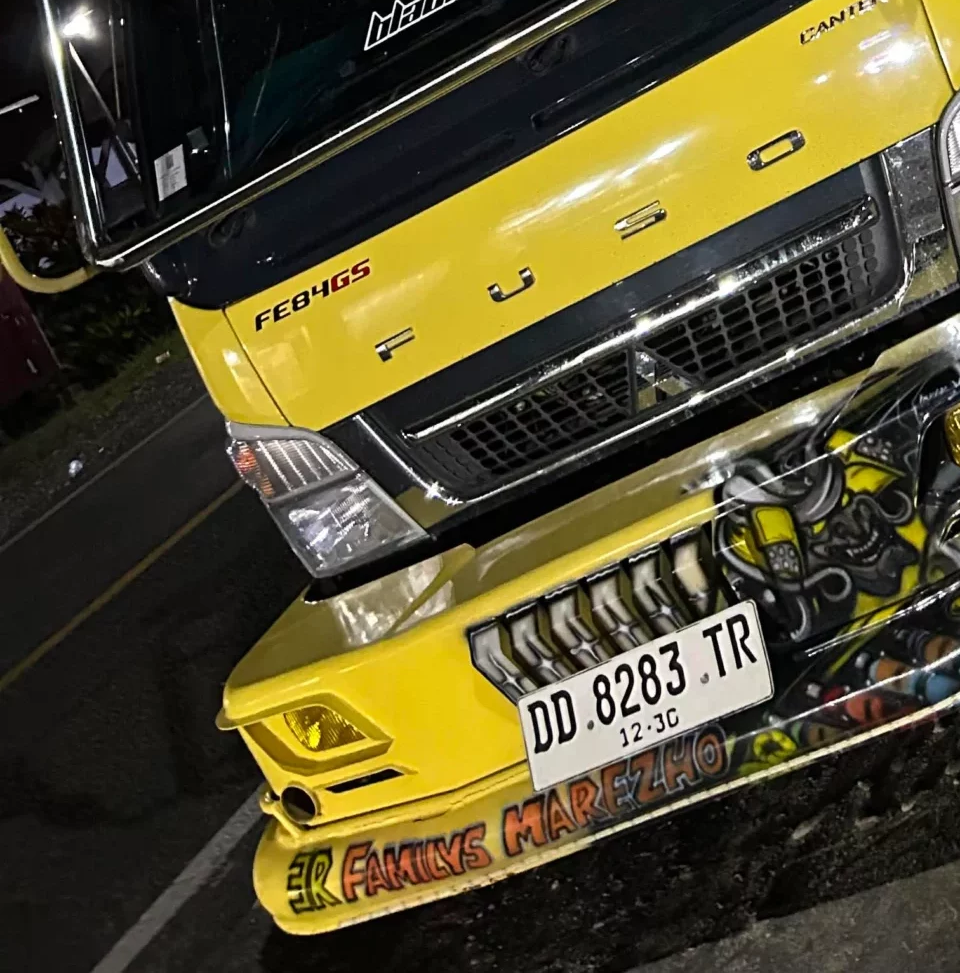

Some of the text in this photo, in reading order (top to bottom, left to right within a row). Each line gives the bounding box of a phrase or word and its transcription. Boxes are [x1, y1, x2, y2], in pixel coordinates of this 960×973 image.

[254, 257, 371, 332] FE84GS
[527, 613, 758, 754] DD 8283 TR
[340, 821, 493, 902] FAMILYS
